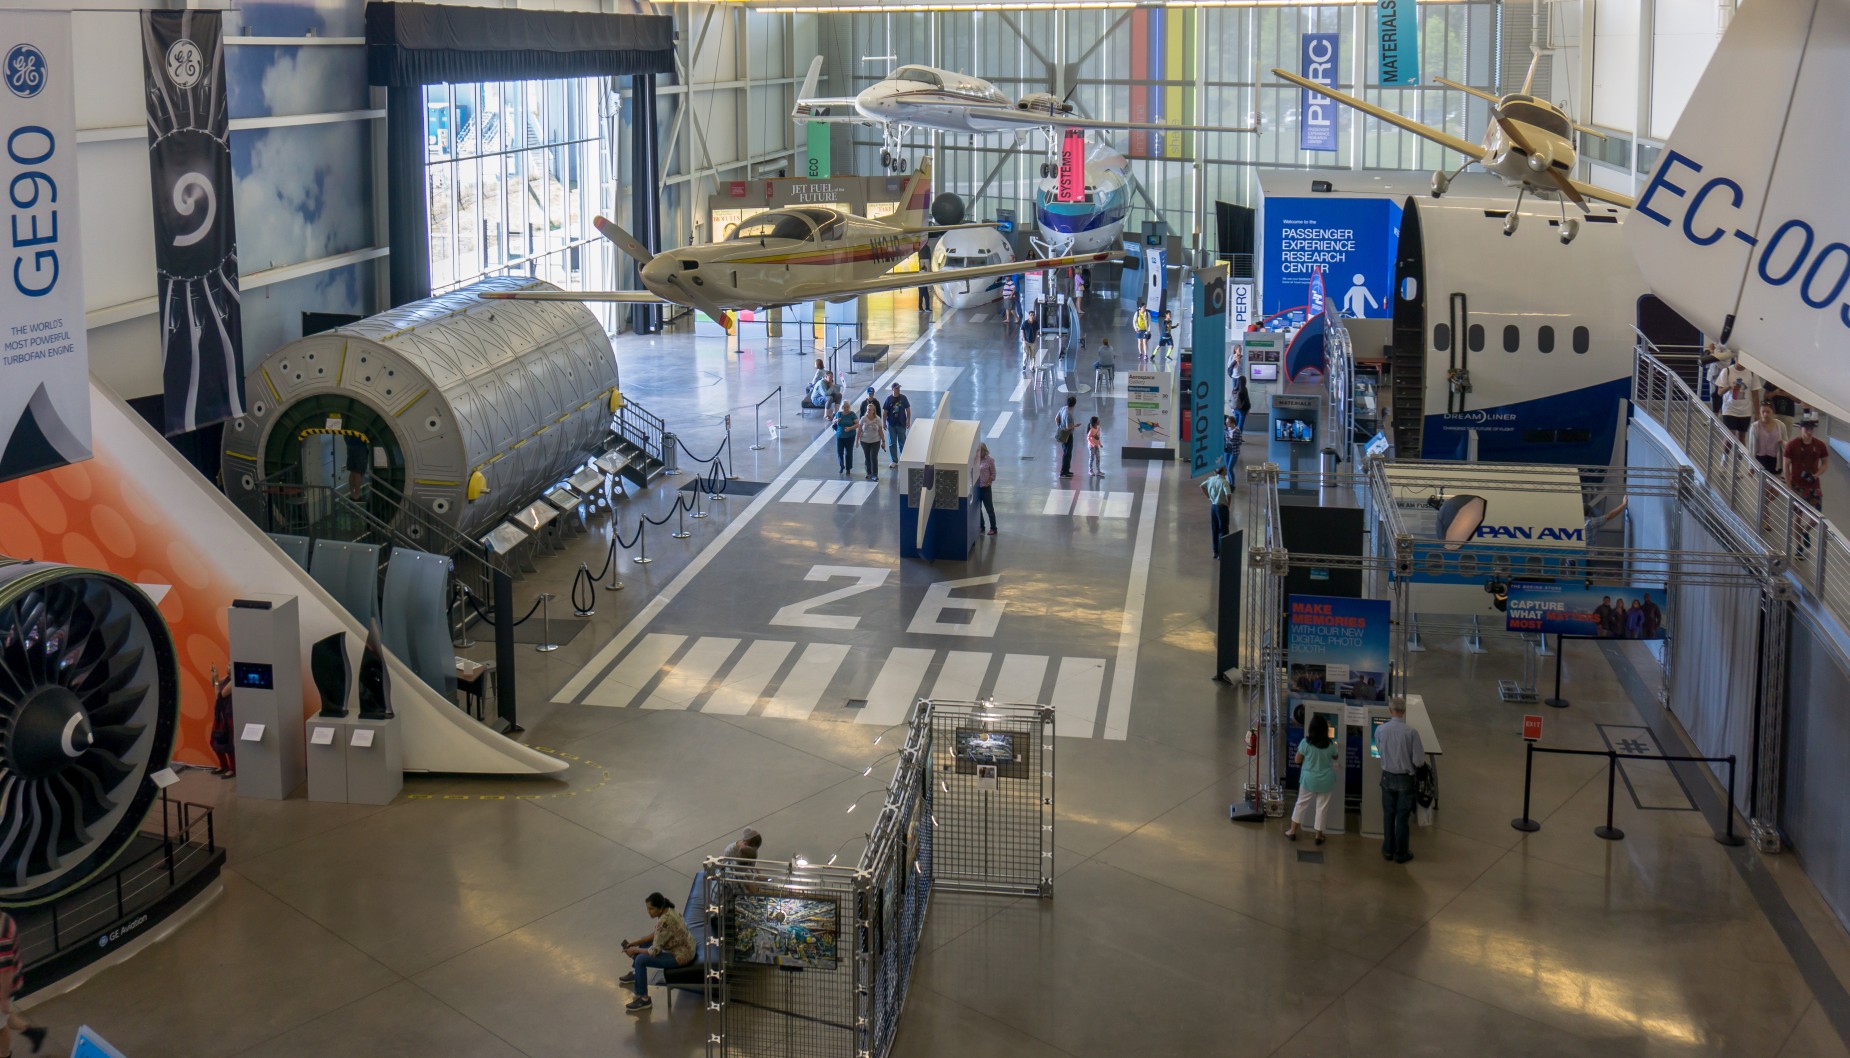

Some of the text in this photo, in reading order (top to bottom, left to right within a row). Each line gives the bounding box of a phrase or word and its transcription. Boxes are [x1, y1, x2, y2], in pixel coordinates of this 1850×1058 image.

[1381, 0, 1398, 83] MATERIALS
[1308, 39, 1332, 126] PERC
[1136, 104, 1144, 153] imaine
[1168, 119, 1180, 154] shae
[809, 158, 819, 177] ECO
[1060, 150, 1071, 199] SYSTEMS
[791, 185, 808, 196] JET
[810, 183, 834, 193] FUEL
[799, 192, 838, 202] FUTURE
[7, 125, 59, 298] GE90
[1282, 228, 1353, 240] PASSENGER
[1282, 240, 1356, 251] EXPERIENCE
[1282, 252, 1346, 262] RESEARCH
[1236, 287, 1247, 322] PERC
[11, 318, 63, 336] THE WORLD'S
[4, 331, 71, 351] MOST POWERFUL
[3, 344, 75, 366] TURBOFAN ENGINE
[1195, 381, 1209, 470] PHOTO
[1476, 525, 1585, 542] PAN AM
[768, 564, 1007, 637] 26
[1292, 602, 1332, 614] MAKE
[1510, 600, 1565, 611] CAPTURE
[1292, 614, 1366, 628] MEMORIES
[1510, 610, 1601, 623] WHAT MATTERS
[1510, 620, 1543, 630] MOST
[1291, 624, 1364, 638] WITH OUR NEW
[1291, 634, 1362, 647] DIGITAL PHOTO
[1291, 644, 1326, 655] BOOTH
